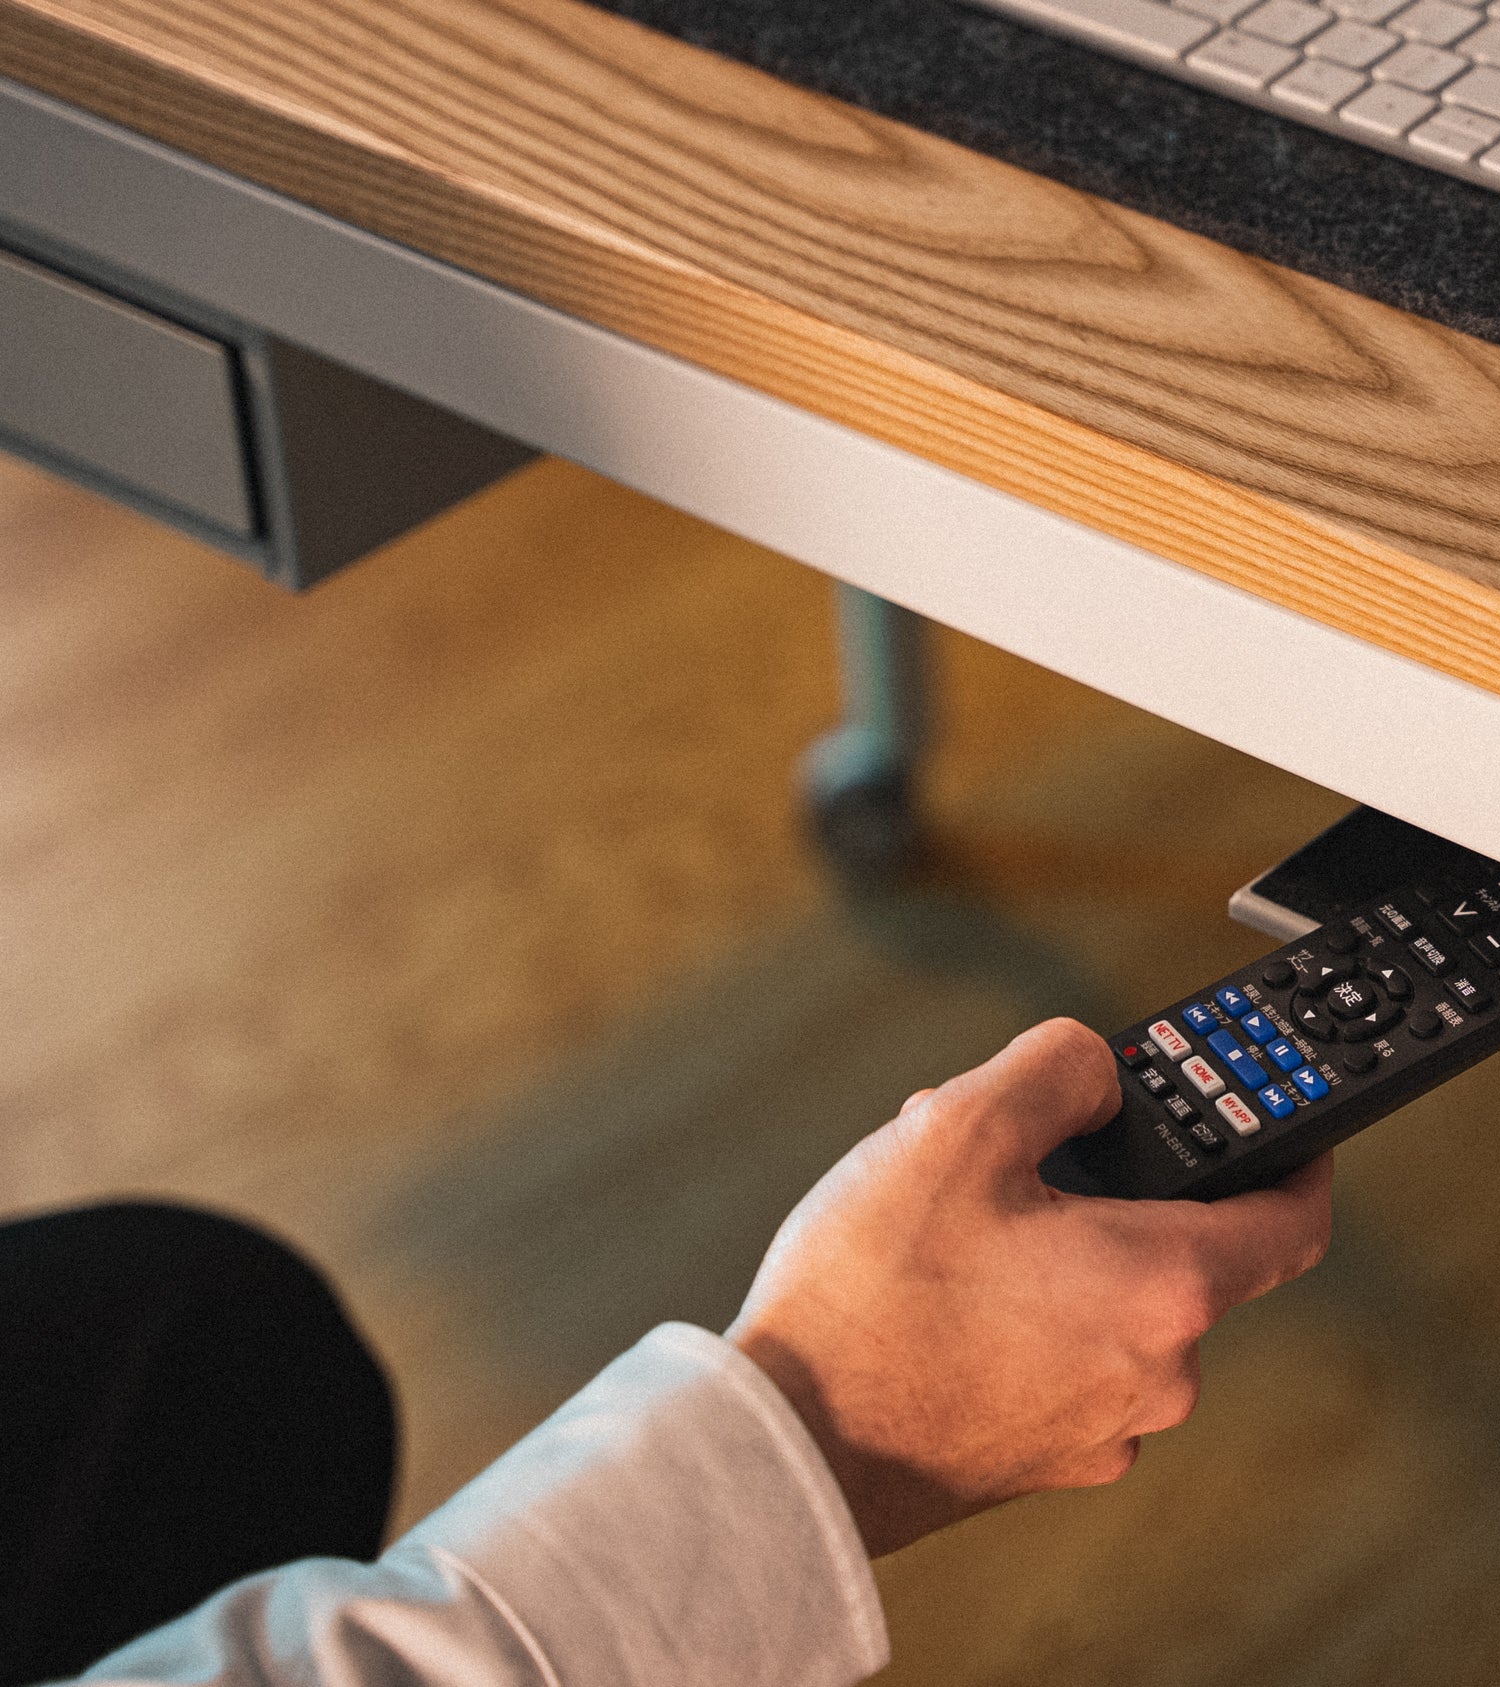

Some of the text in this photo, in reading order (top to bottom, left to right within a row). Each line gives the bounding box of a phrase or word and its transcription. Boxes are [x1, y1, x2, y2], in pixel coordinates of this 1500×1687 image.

[1378, 903, 1412, 931] 元の画面
[1413, 936, 1447, 966] 音声切換
[1242, 984, 1262, 1005] 早戻し
[1333, 981, 1363, 1007] 決定
[1454, 978, 1477, 998] 消音
[1204, 1001, 1232, 1025] スキップ
[1434, 1001, 1464, 1027] 番組表
[1153, 1022, 1186, 1051] NET TV
[1292, 1034, 1318, 1062] 一時停止
[1373, 1039, 1396, 1057] 戻る
[1246, 1045, 1263, 1061] 停止
[1142, 1068, 1166, 1093] 字幕
[1190, 1063, 1214, 1084] HOME
[1319, 1064, 1342, 1085] 早送り
[1167, 1094, 1192, 1118] 2画面
[1280, 1081, 1310, 1106] スキップ
[1222, 1097, 1251, 1125] MY APP
[1154, 1123, 1198, 1168] PN-E612-B
